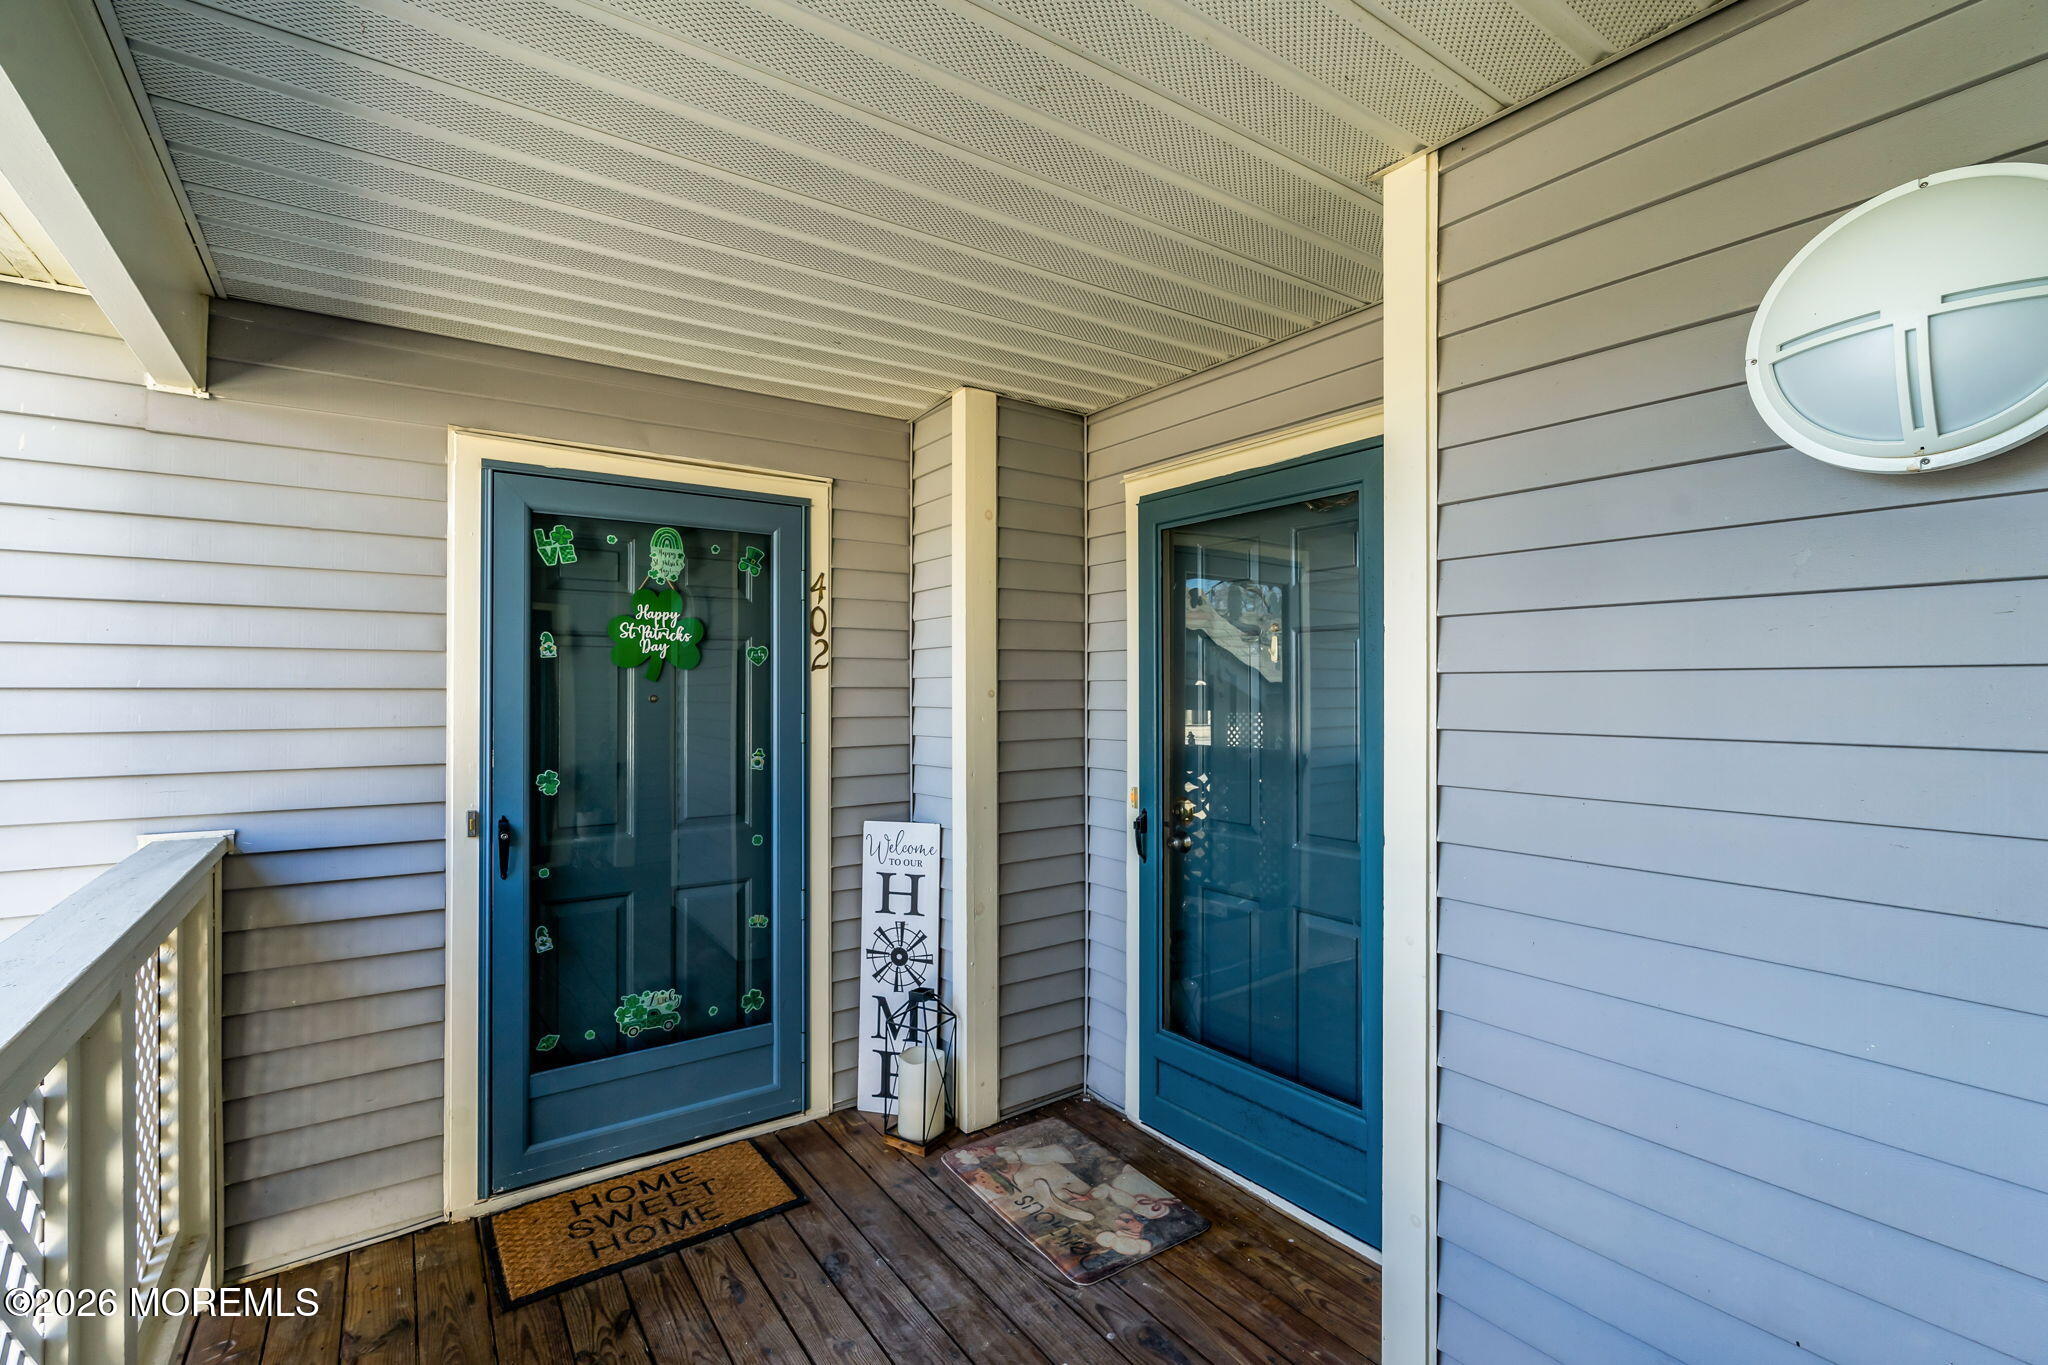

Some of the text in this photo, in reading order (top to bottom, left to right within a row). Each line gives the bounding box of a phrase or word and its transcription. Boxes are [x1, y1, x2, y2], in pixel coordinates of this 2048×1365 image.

[635, 604, 681, 628] Happy
[639, 624, 692, 642] Patricks
[810, 572, 829, 672] 402
[640, 639, 669, 659] Day
[865, 829, 937, 865] Welcome
[888, 858, 923, 868] TO OUR
[567, 1178, 716, 1239] SWEET
[570, 1166, 699, 1216] HOME
[588, 1203, 725, 1259] HOME
